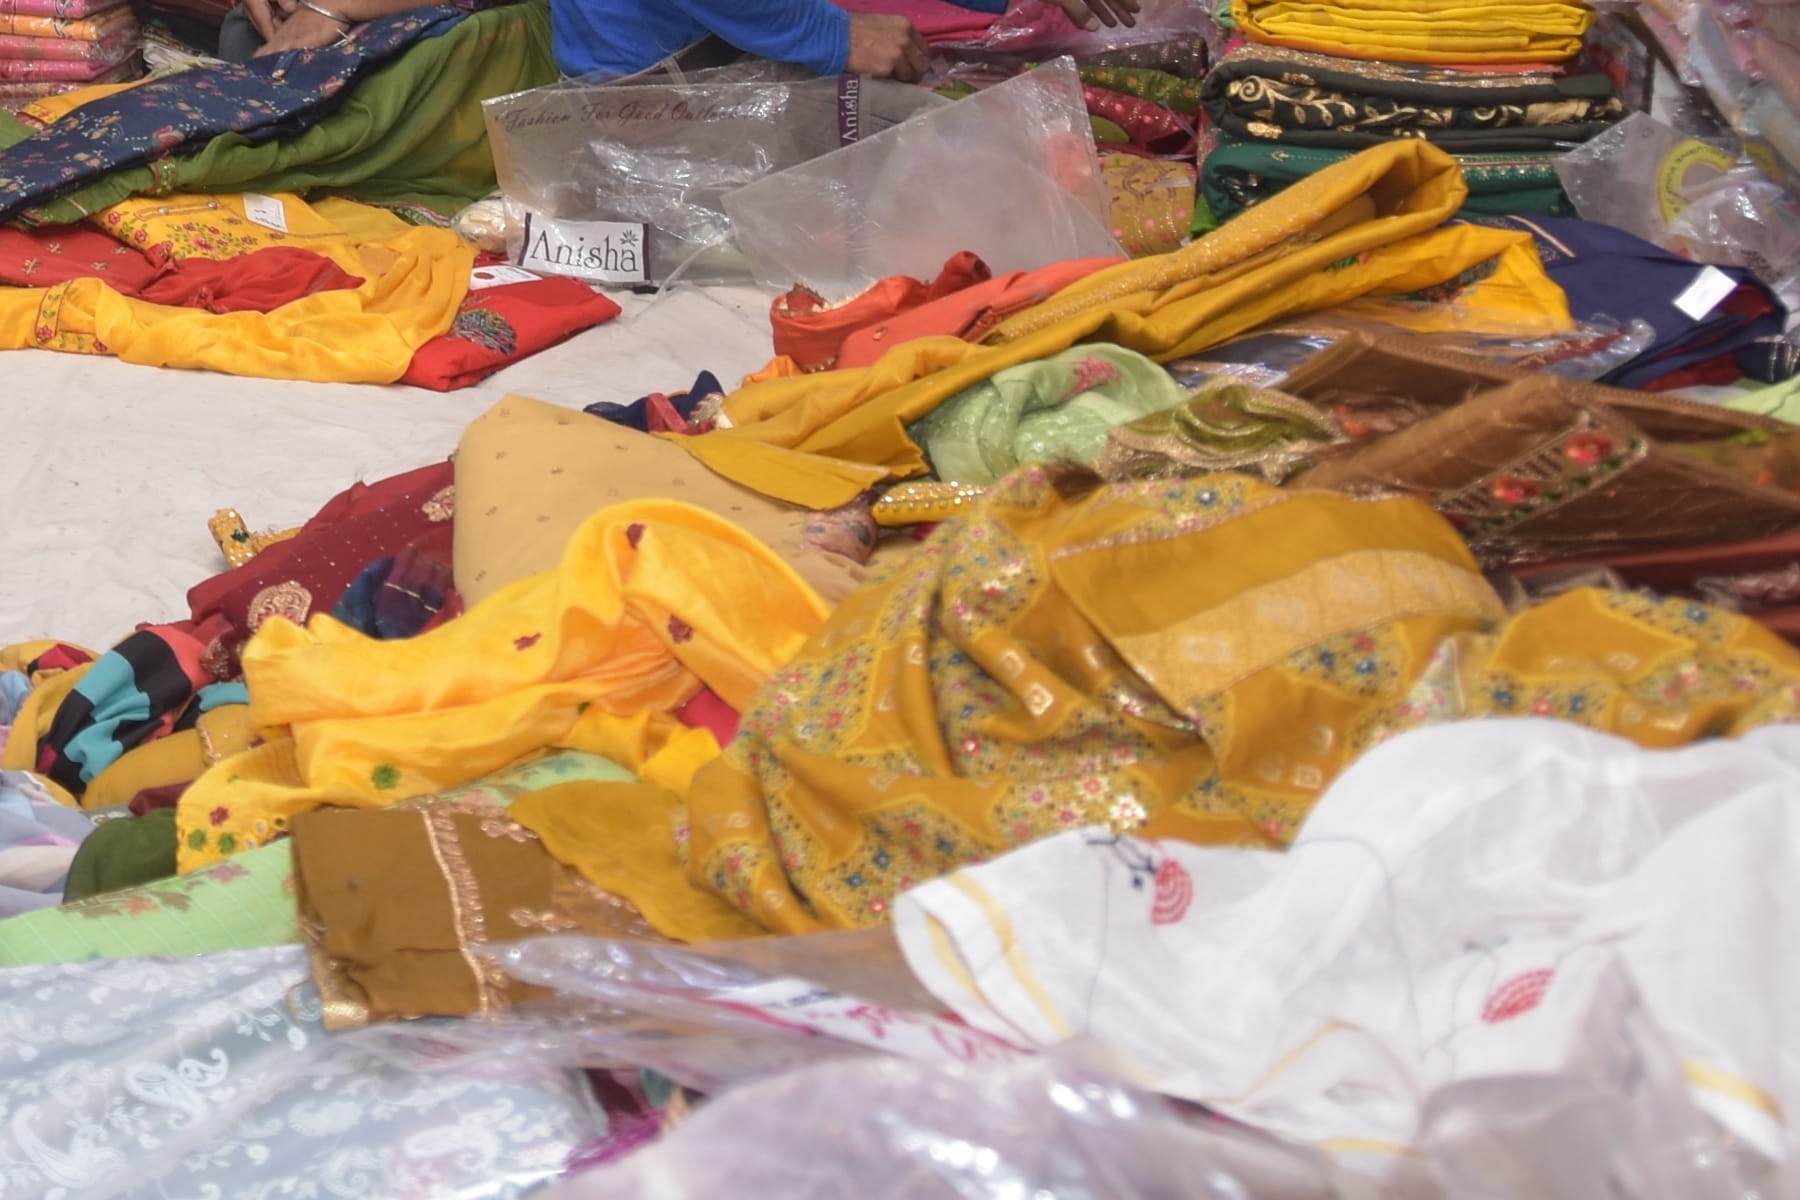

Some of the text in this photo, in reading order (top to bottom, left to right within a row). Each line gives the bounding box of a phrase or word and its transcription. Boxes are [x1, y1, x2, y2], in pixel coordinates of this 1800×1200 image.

[502, 107, 572, 132] Fashion
[581, 103, 611, 122] For
[619, 101, 667, 127] Good
[840, 79, 859, 142] Anisha
[530, 228, 639, 273] Anisha
